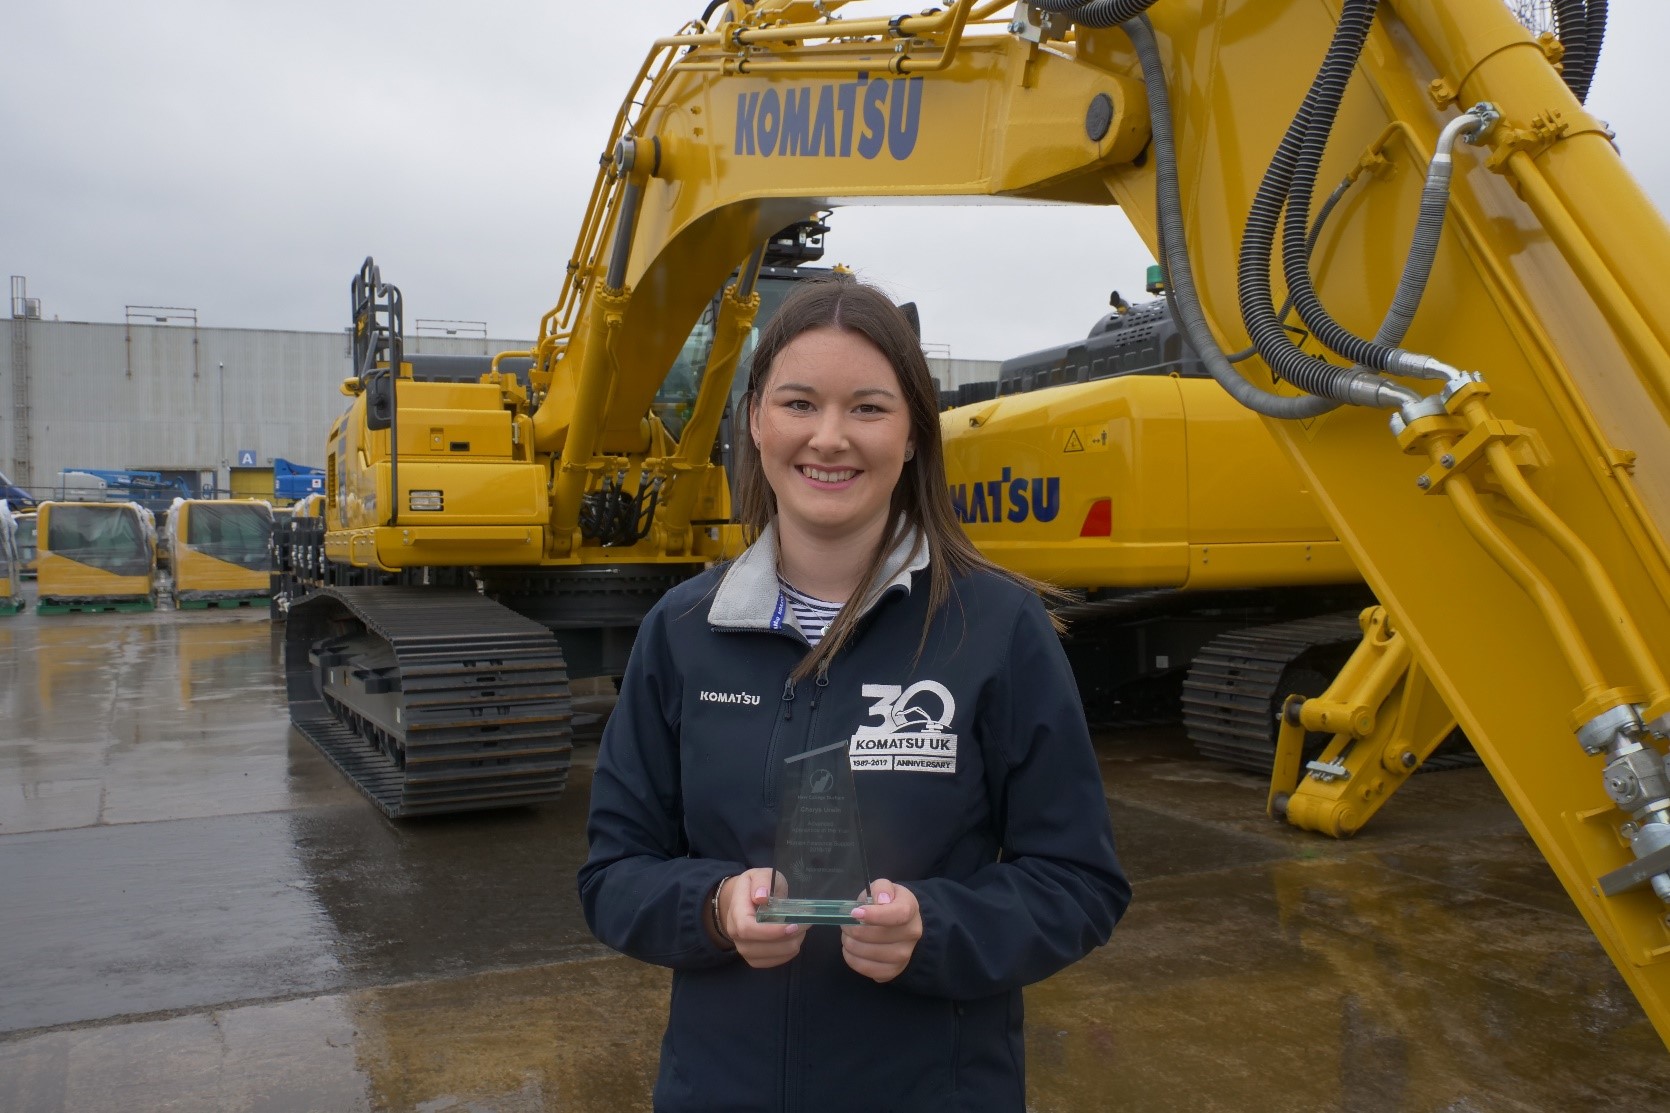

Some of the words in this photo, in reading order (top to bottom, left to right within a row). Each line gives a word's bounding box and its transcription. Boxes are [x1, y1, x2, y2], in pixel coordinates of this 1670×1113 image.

[734, 70, 924, 161] KOMATSU
[242, 453, 253, 464] A
[950, 467, 1061, 524] MATSU
[699, 691, 761, 705] KOMATSU
[855, 738, 925, 751] KOMATSU
[929, 739, 951, 751] UK
[896, 760, 952, 769] ANNIVERSARY
